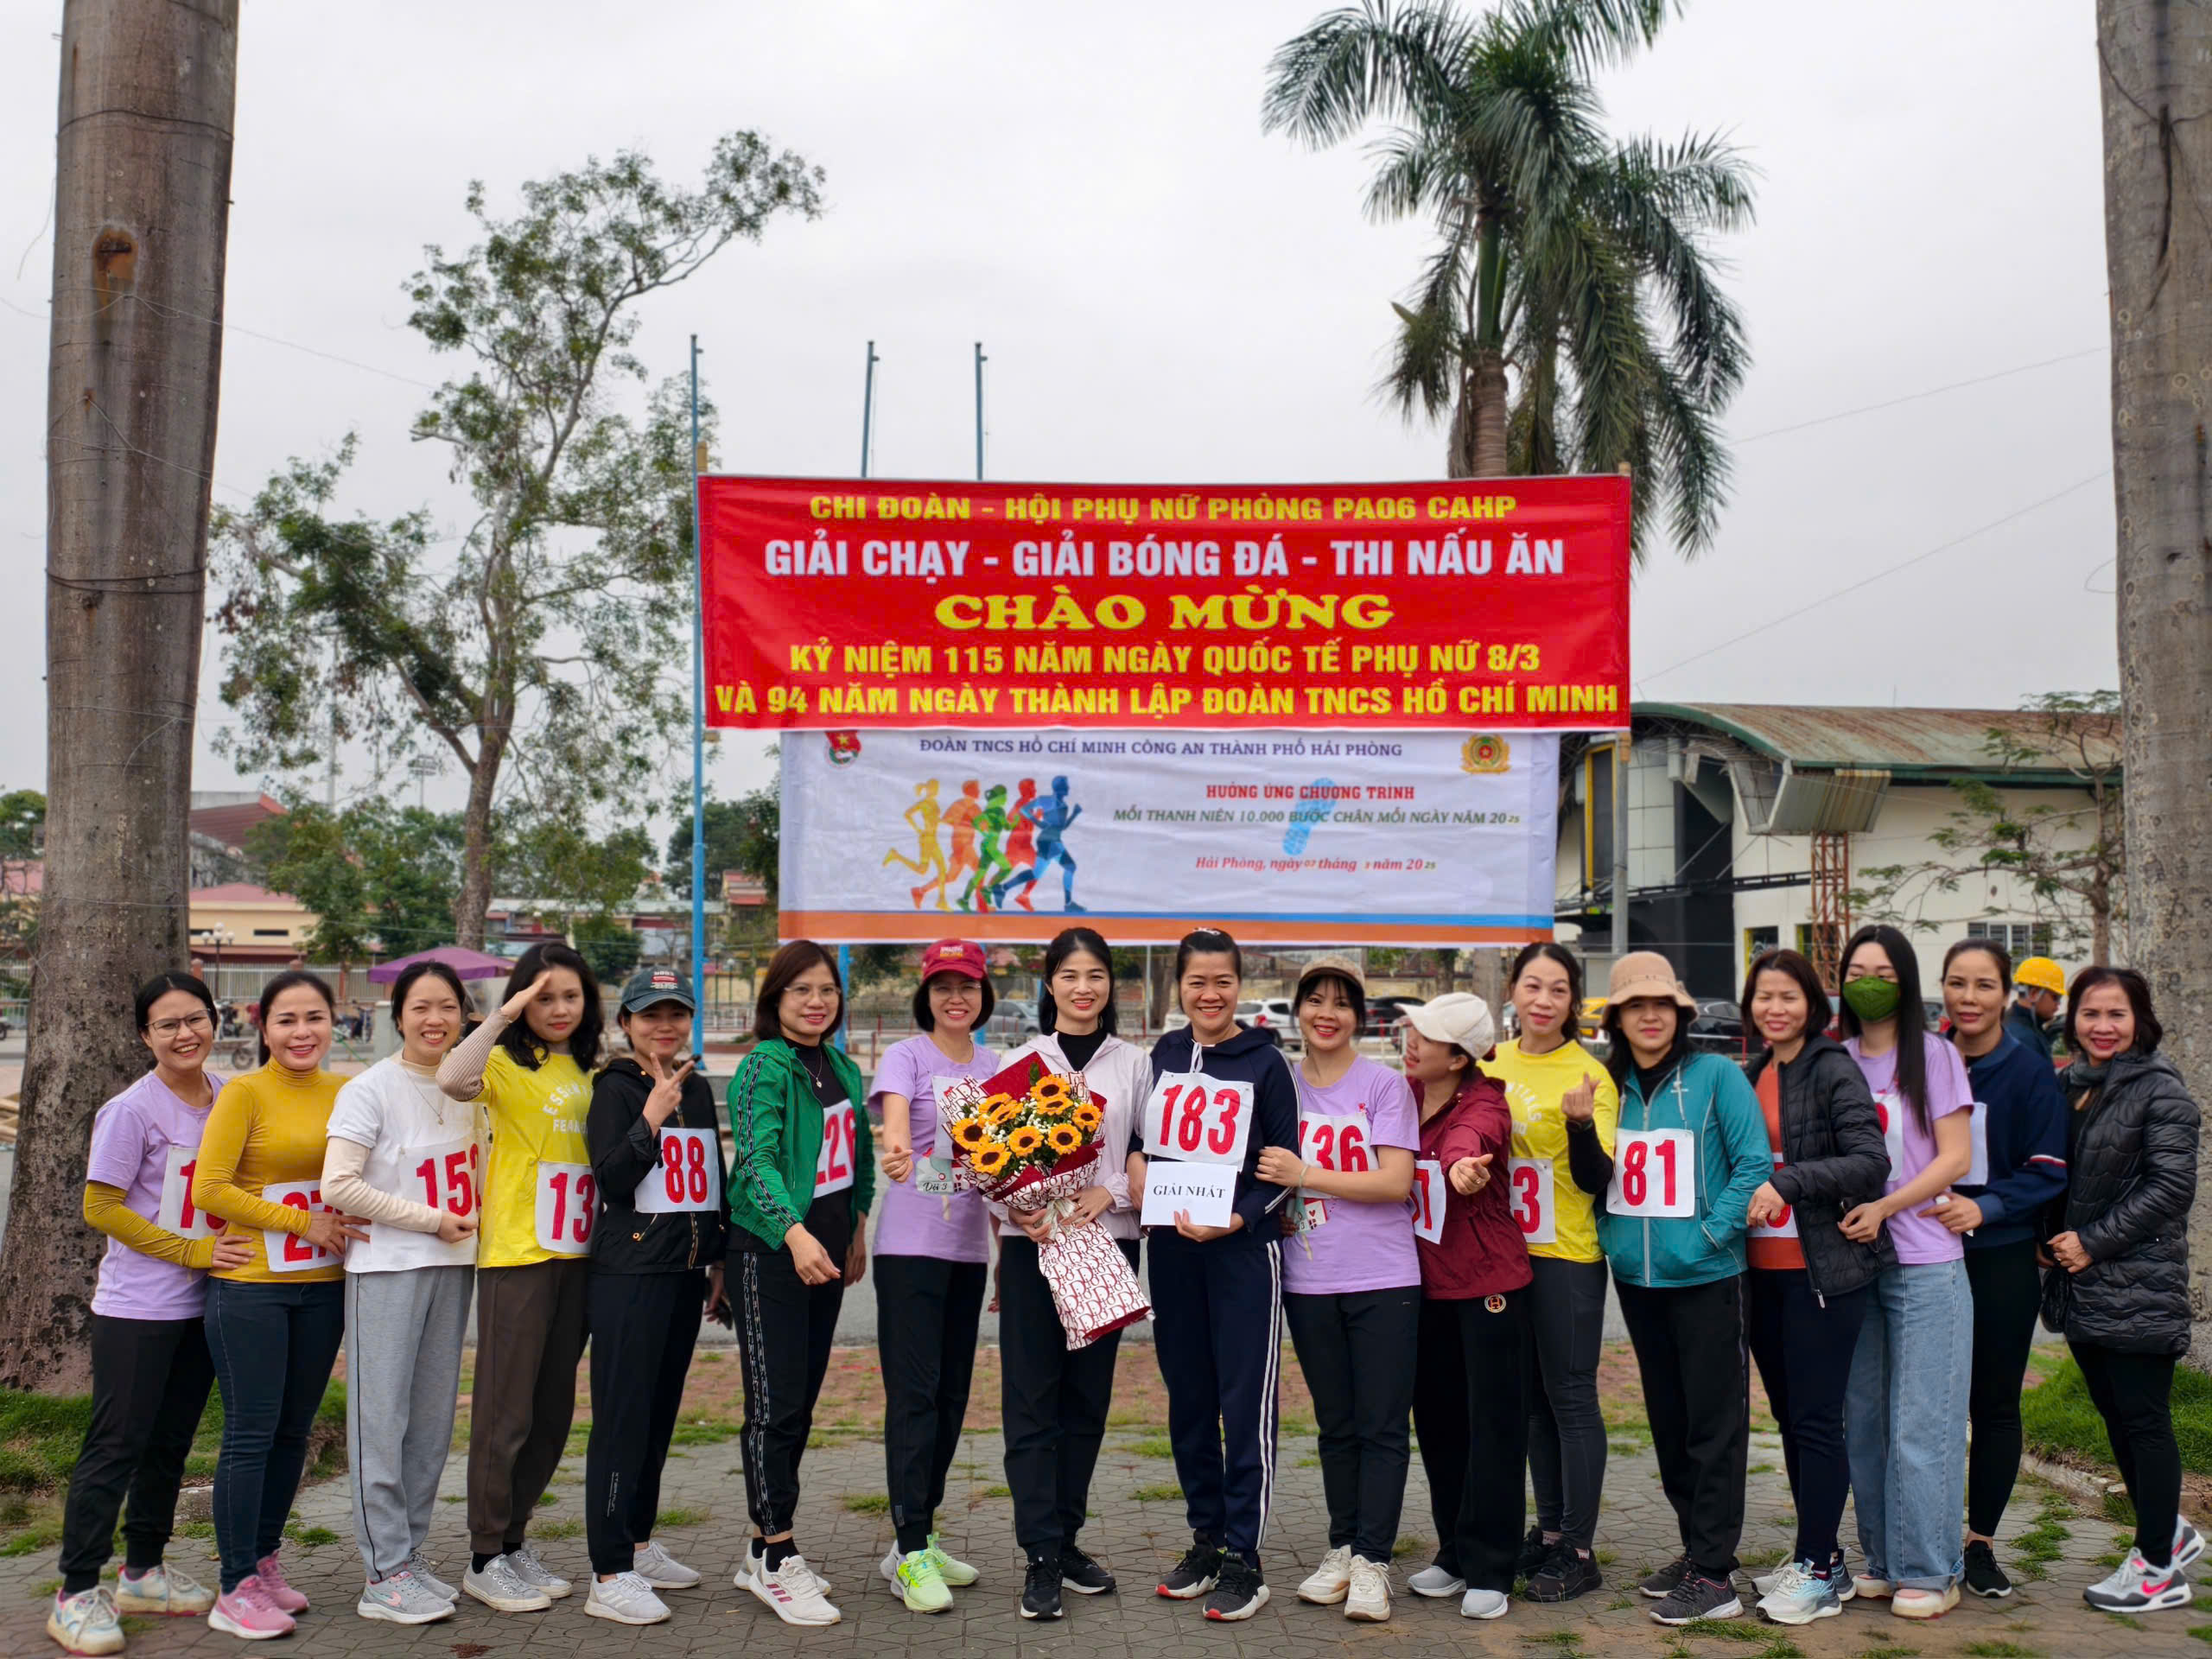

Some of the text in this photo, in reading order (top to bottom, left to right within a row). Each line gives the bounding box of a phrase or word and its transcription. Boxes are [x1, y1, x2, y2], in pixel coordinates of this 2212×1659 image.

[810, 496, 866, 518] CHI
[877, 493, 970, 518] ĐOÀN
[1006, 494, 1061, 524] HỘI
[1073, 499, 1139, 524] PHỤ
[1151, 497, 1199, 520] NỮ
[1209, 493, 1322, 520] PHÒNG
[1334, 498, 1416, 520] PA06
[1427, 497, 1516, 519] CAHP
[766, 529, 847, 575] GIẢI
[863, 541, 969, 583] CHẠY
[1014, 530, 1093, 575] GIẢI
[1109, 534, 1219, 575] BÓNG
[1234, 534, 1288, 575] ĐÁ
[1331, 541, 1392, 575] THI
[1408, 528, 1491, 575] NẤU
[1506, 533, 1563, 574] ĂN
[935, 584, 1394, 629] CHÀO MỪNG
[791, 637, 1540, 678] KỶ NIỆM 115 NĂM NGÀY QUỐC TẾ PHỤ NỮ 8/3
[715, 677, 1617, 720] VÀ 94 NĂM NGÀY THÀNH LẬP ĐOÀN TNCS HỒ CHÍ MINH
[920, 734, 1402, 756] ĐOÀN TNCS HỒ CHÍ MINH CÔNG AN THÀNH PHỐ HẢI PHÒNG
[1147, 810, 1196, 822] THANH
[1200, 808, 1234, 822] NIÊN
[1240, 810, 1284, 822] 10.000
[1333, 809, 1377, 823] CHÂN
[1410, 809, 1449, 823] NGÀY
[1453, 809, 1486, 823] NĂM
[1160, 1084, 1240, 1154] 183
[663, 1135, 708, 1204] 88
[1153, 1182, 1182, 1196] GIẢI
[1624, 1140, 1676, 1206] 81
